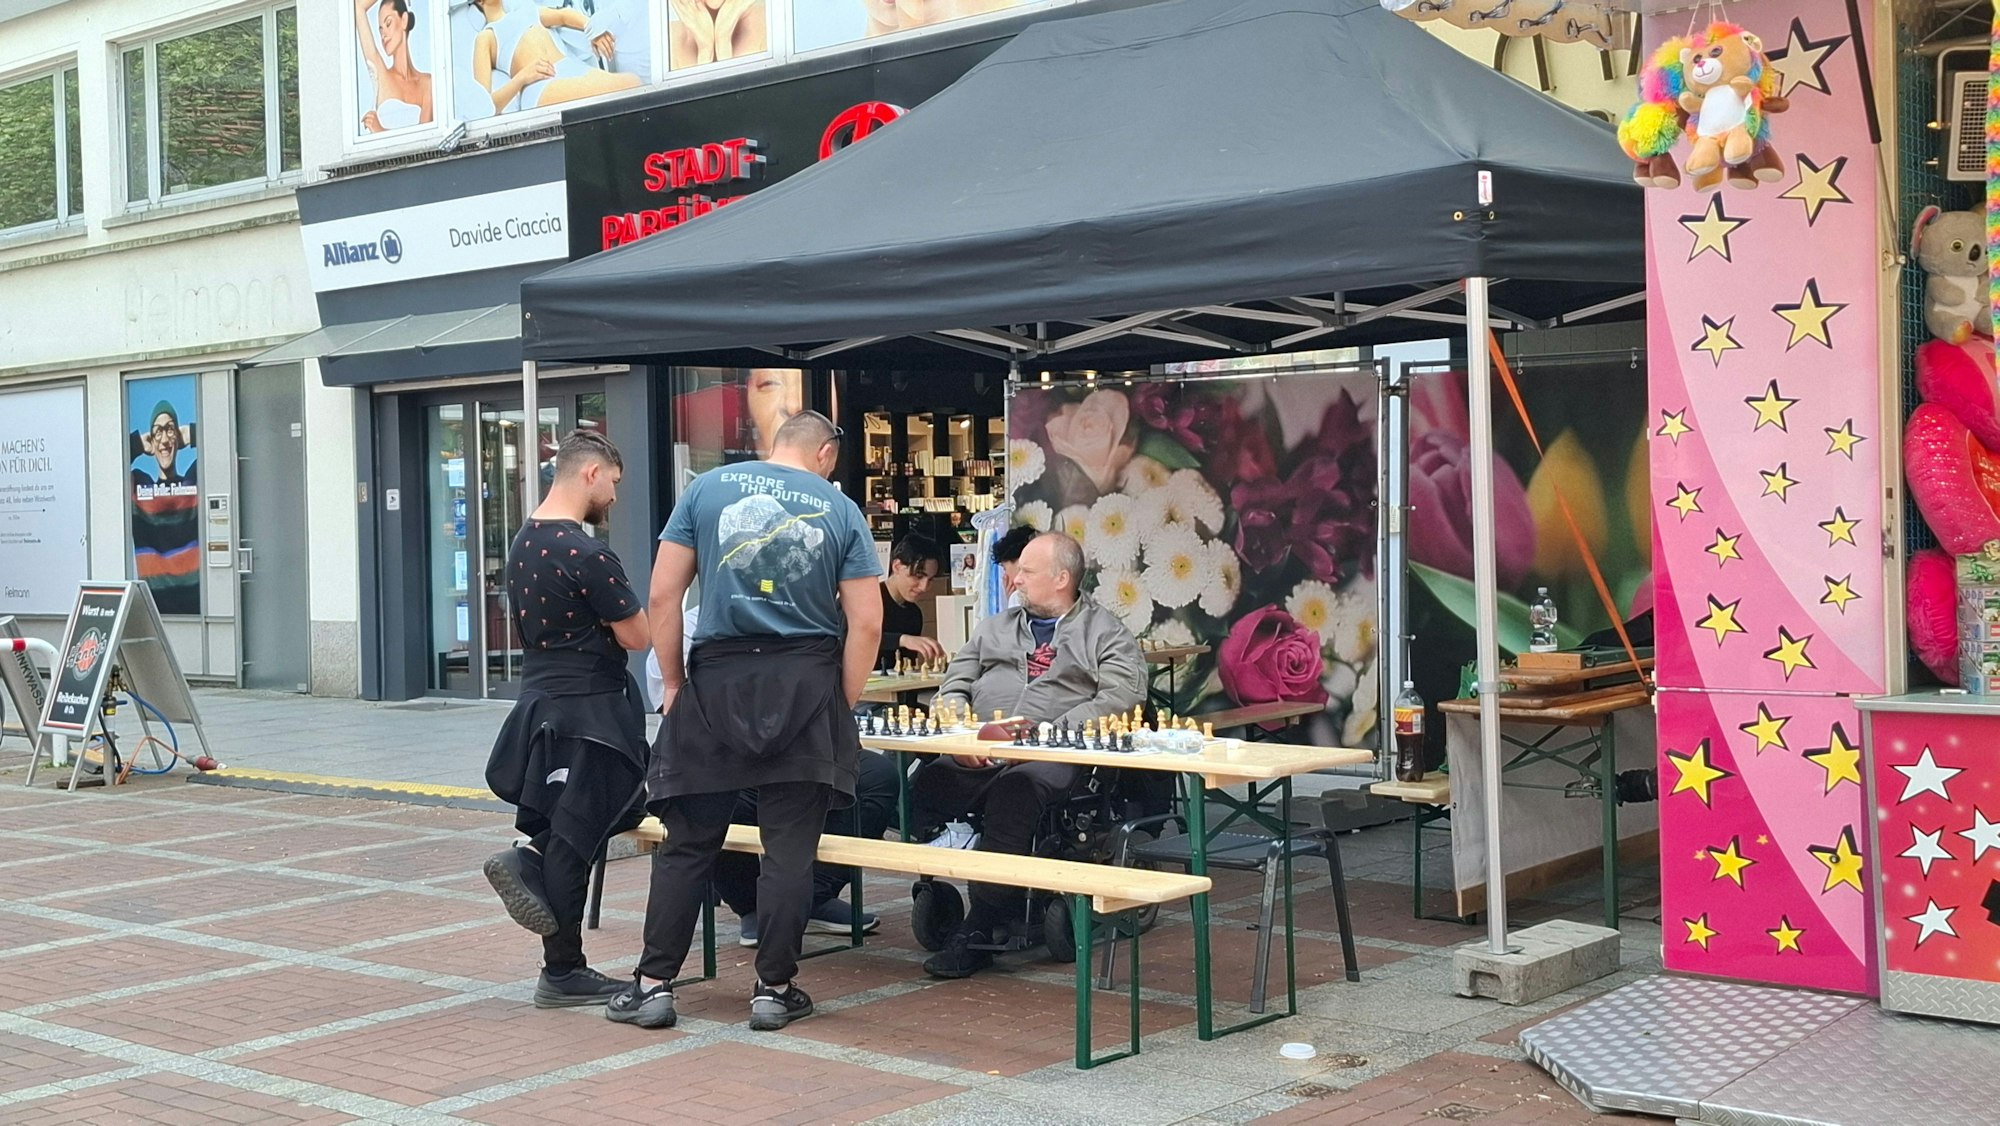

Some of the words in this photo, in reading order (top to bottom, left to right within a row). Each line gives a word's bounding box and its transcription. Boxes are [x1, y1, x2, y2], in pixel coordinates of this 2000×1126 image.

[643, 137, 760, 192] STADT-
[449, 220, 502, 248] Davide
[505, 212, 562, 240] Ciaccia
[323, 241, 379, 267] Allianz
[1, 438, 45, 455] MACHEN'S
[10, 456, 26, 473] FÜR
[28, 457, 53, 472] DICH.
[721, 472, 785, 489] EXPLORE
[740, 482, 768, 496] THE
[772, 488, 832, 513] OUTSIDE
[82, 604, 99, 616] Wurst
